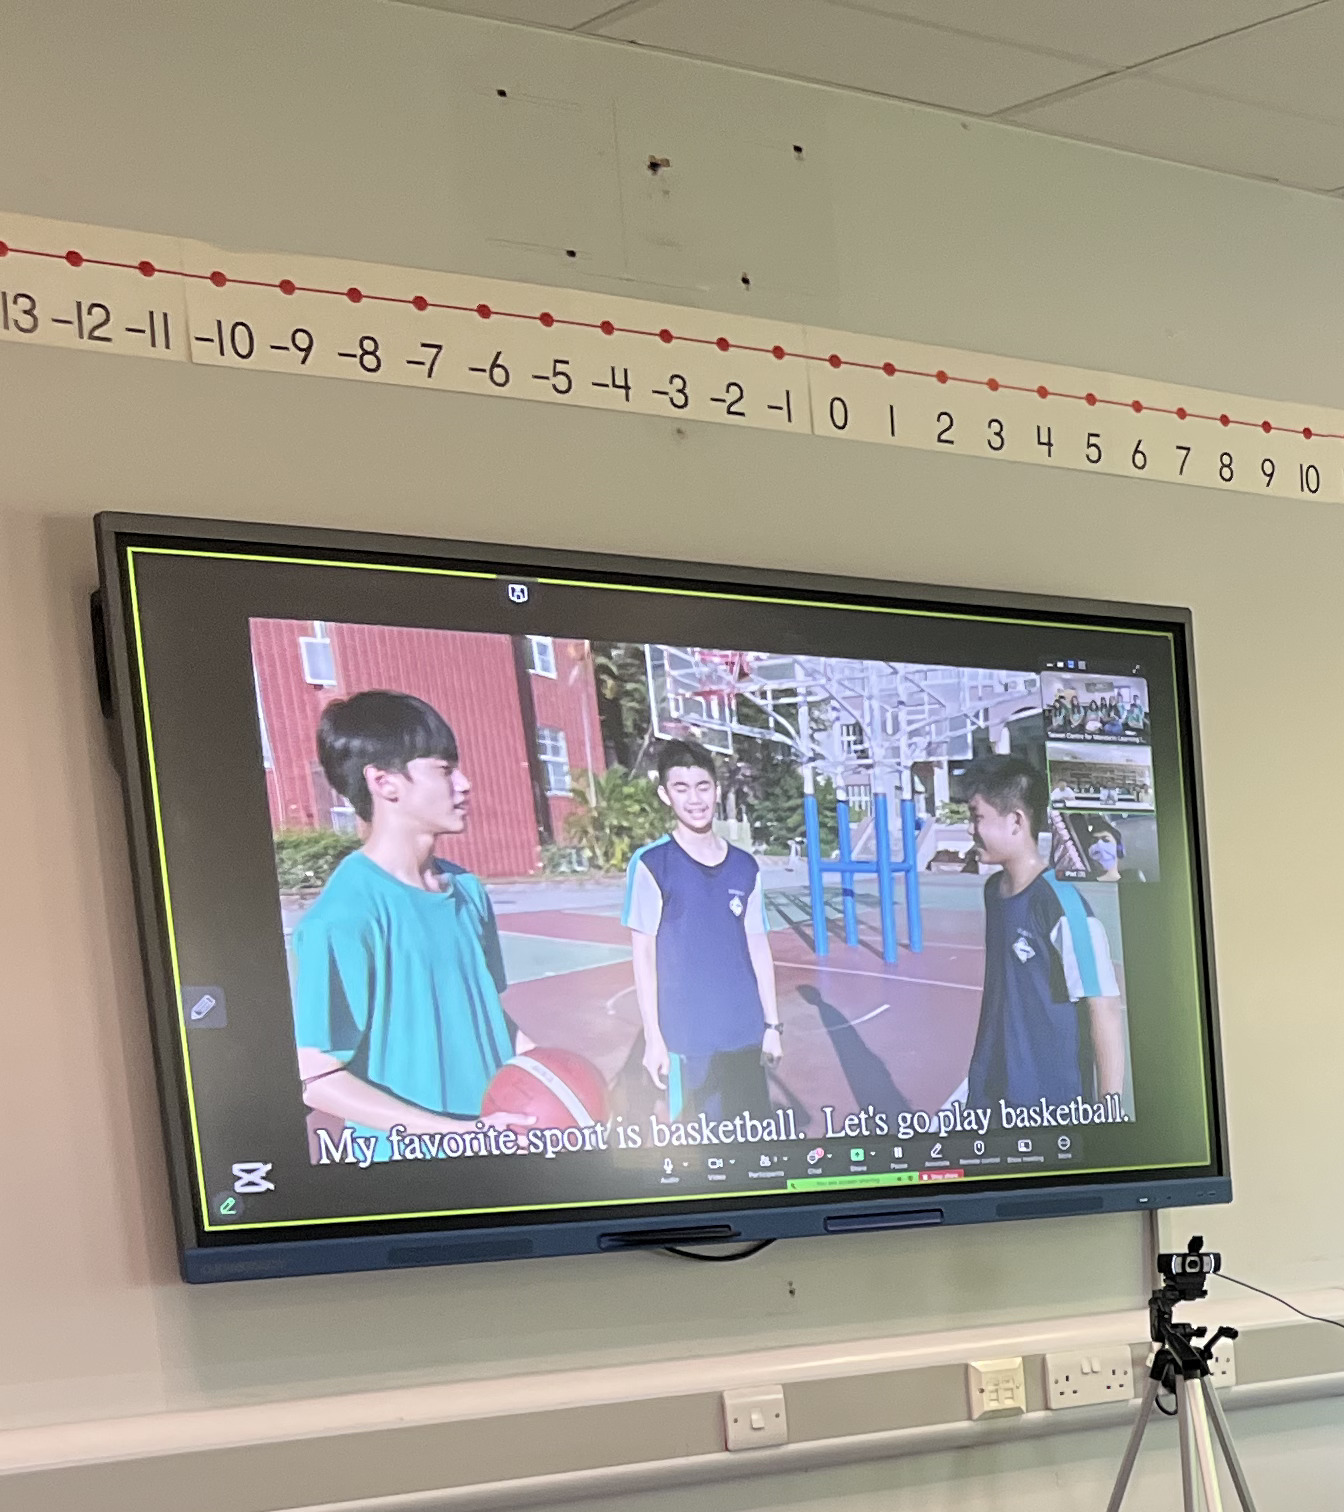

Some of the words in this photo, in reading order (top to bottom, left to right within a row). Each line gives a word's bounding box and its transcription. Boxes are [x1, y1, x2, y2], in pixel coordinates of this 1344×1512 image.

[829, 396, 849, 431] 0
[936, 411, 955, 446] 2
[986, 418, 1005, 452] 3
[1036, 424, 1054, 458] 4
[1085, 432, 1102, 465] 5
[1131, 438, 1148, 471] 6
[1175, 445, 1192, 476] 7
[1218, 451, 1234, 483] 8
[1260, 457, 1276, 488] 9
[1299, 463, 1321, 495] 10
[315, 1126, 378, 1169] My
[387, 1120, 519, 1161] favorite
[528, 1119, 609, 1160] sport
[616, 1117, 642, 1148] is
[650, 1108, 806, 1148] basketball.
[823, 1104, 888, 1139] Let's
[897, 1112, 931, 1139] go
[936, 1106, 993, 1137] play
[999, 1092, 1131, 1130] basketball.
